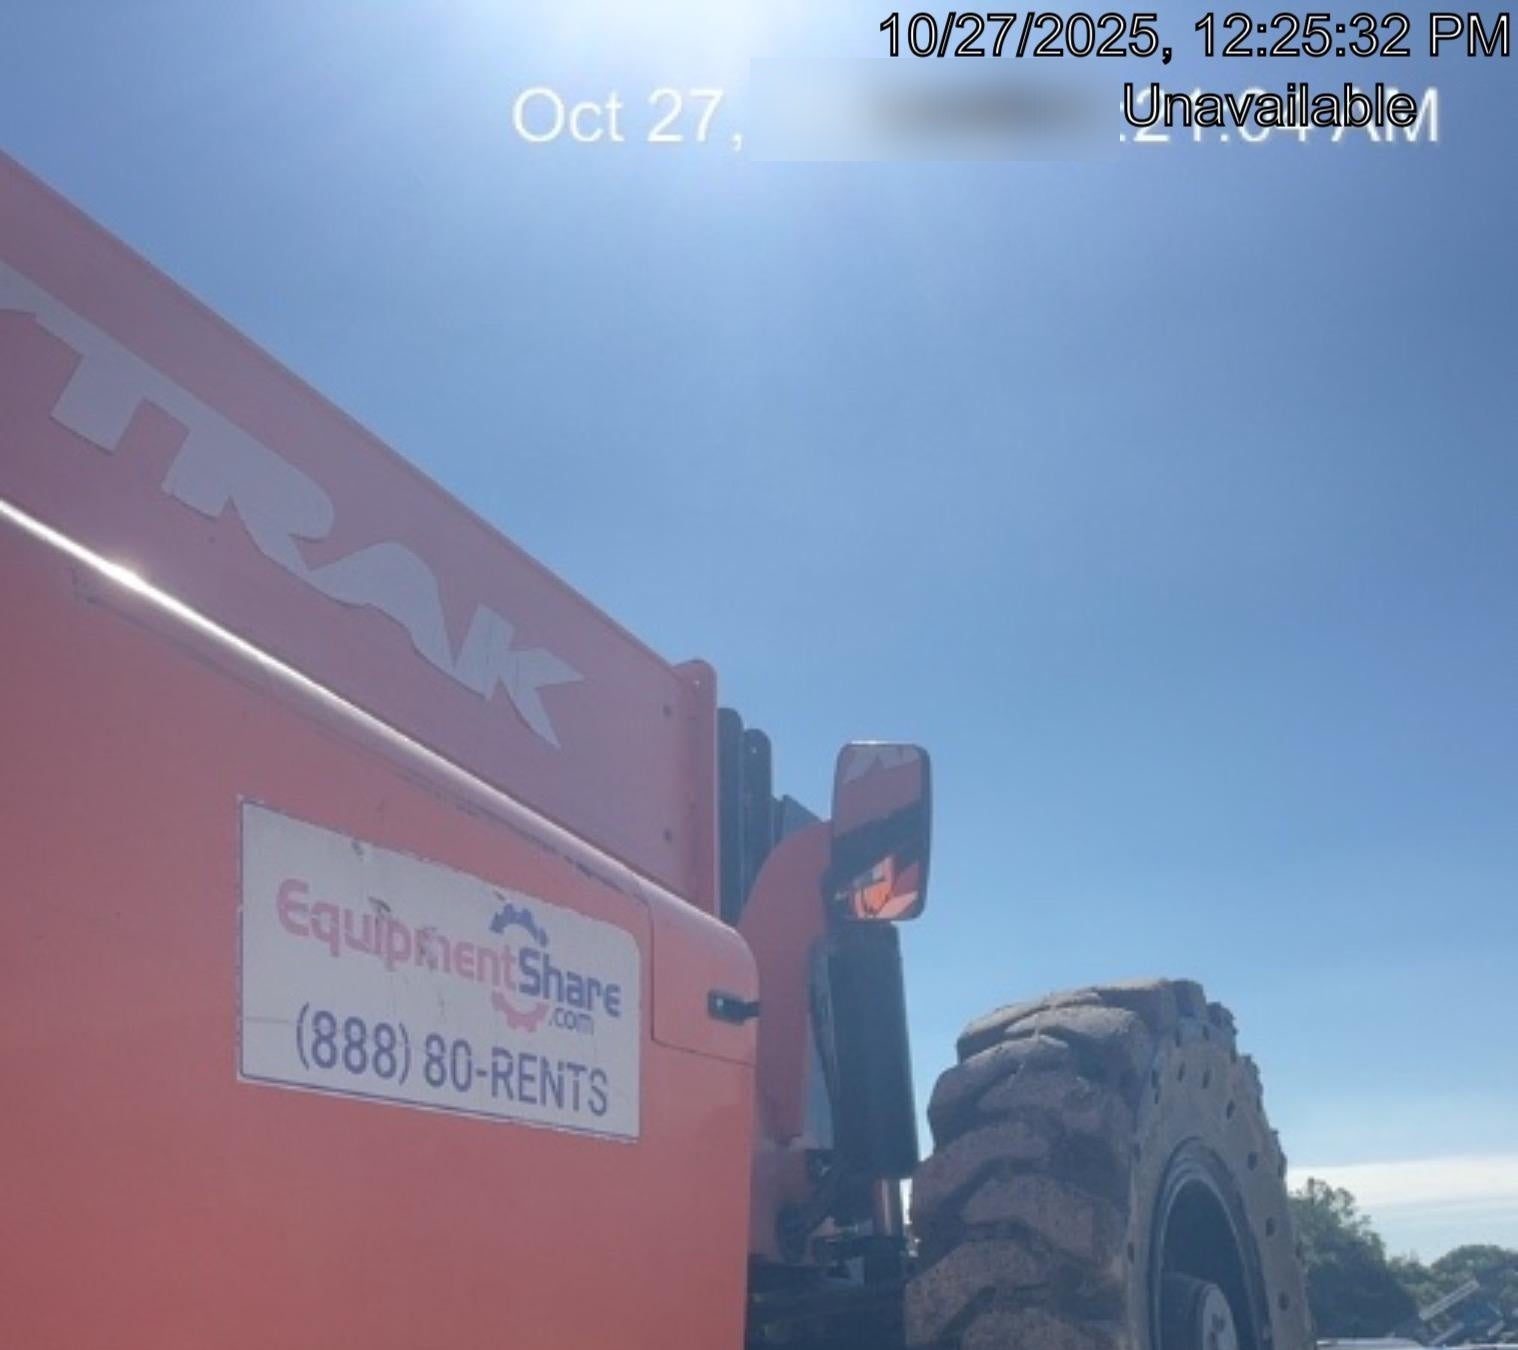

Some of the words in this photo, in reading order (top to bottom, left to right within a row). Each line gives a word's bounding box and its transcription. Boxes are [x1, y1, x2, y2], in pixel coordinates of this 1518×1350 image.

[0, 257, 586, 752] TRAK
[275, 877, 622, 1020] EquipmentShare
[296, 1002, 410, 1086] (888)
[423, 1033, 608, 1117] 80-RENTS
